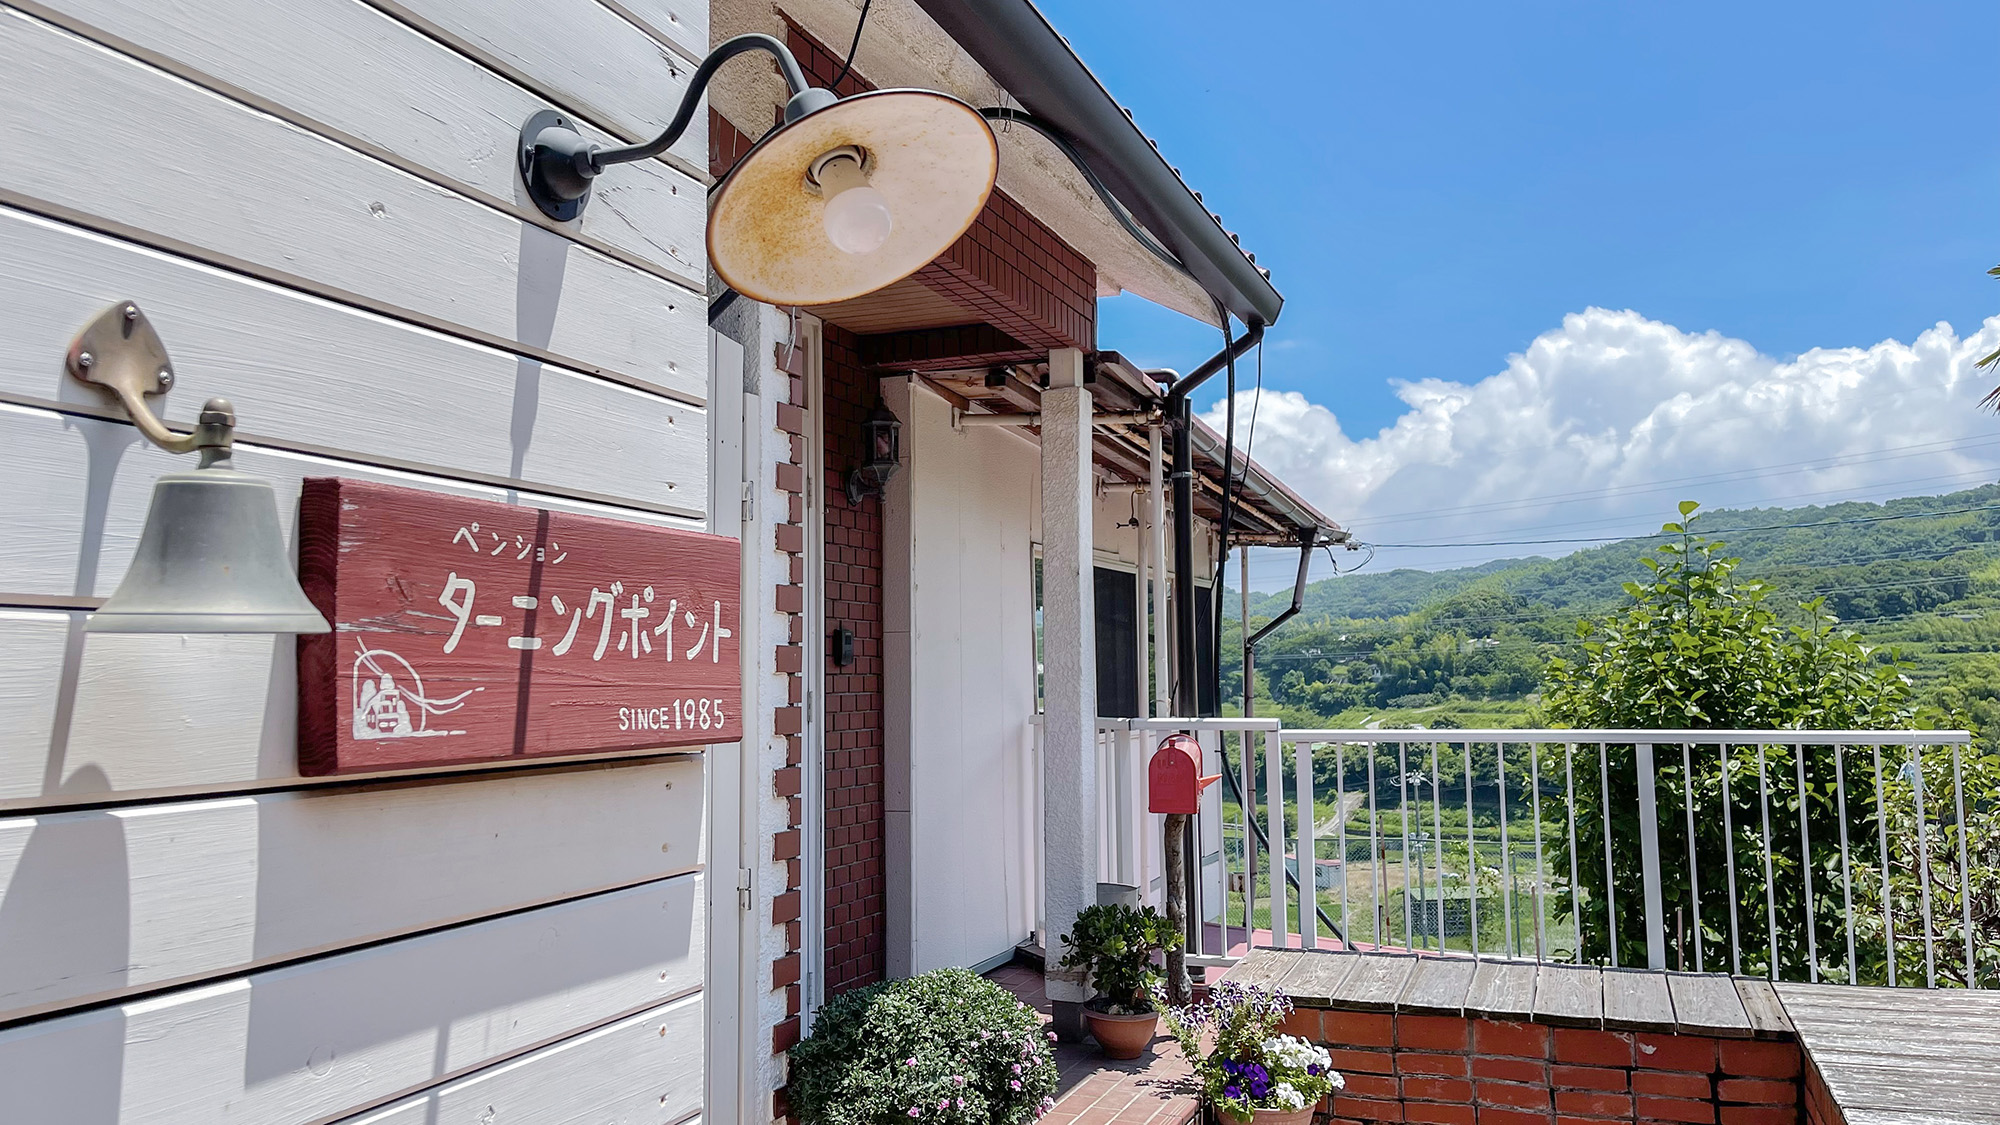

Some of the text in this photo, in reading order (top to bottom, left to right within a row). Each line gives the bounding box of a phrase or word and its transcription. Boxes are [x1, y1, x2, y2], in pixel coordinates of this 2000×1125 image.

[453, 522, 567, 564] ペンション
[439, 571, 732, 663] ターニングポイント
[619, 698, 725, 731] SINCE 1985
